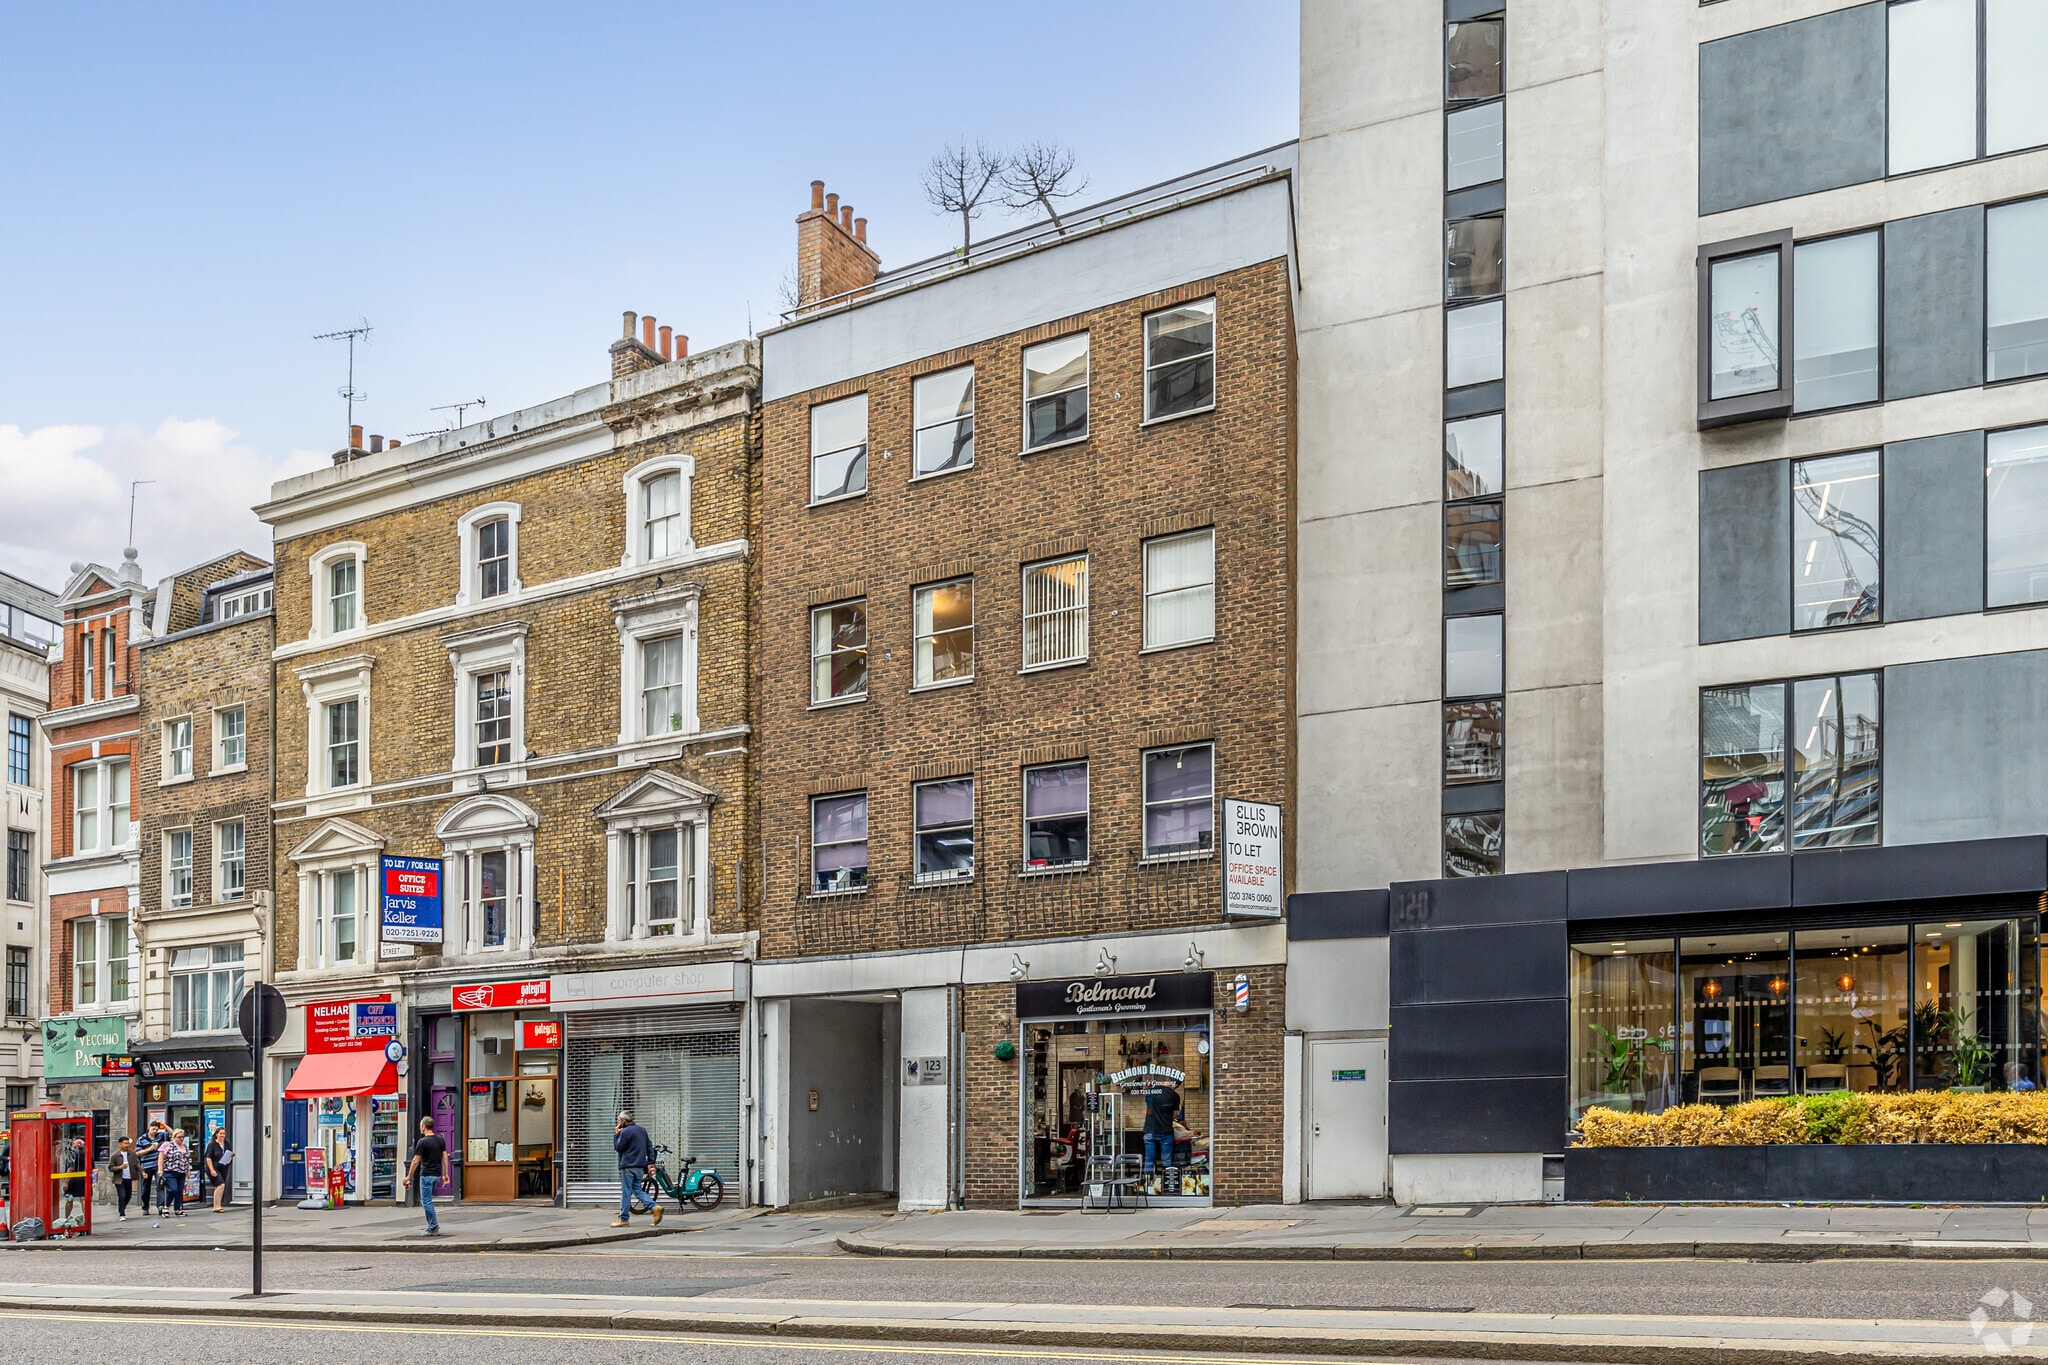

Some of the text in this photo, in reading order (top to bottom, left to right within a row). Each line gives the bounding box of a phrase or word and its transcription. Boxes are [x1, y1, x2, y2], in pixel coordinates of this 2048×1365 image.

[1236, 805, 1266, 822] ELLIS
[1236, 822, 1278, 840] BROWN
[1228, 842, 1262, 858] TO LET
[384, 859, 394, 868] TO
[394, 860, 406, 868] LET
[1228, 862, 1278, 876] OFFICE SPACE
[398, 874, 426, 884] OFFICE
[1228, 874, 1265, 886] AVAILABLE
[400, 884, 424, 894] SUITES
[384, 896, 416, 910] Jarvis
[1228, 892, 1272, 903] 020 3745 0060
[384, 910, 418, 924] Keller
[386, 928, 439, 938] 020-7251-9226
[382, 947, 400, 956] STREET
[610, 971, 705, 991] computer shop
[520, 982, 546, 998] gategrill
[1064, 978, 1156, 1003] Belmond
[314, 1005, 350, 1018] NELHAR
[367, 1005, 385, 1014] OFF
[1076, 1002, 1146, 1014] Gentlemen's Grooming
[358, 1016, 394, 1026] LICENCE
[358, 1026, 395, 1035] OPEN
[534, 1023, 557, 1036] gategrill
[152, 1060, 215, 1072] MAIL BOXES ETC.
[924, 1060, 941, 1070] 123
[1111, 1063, 1186, 1084] BELMOND BARBERS
